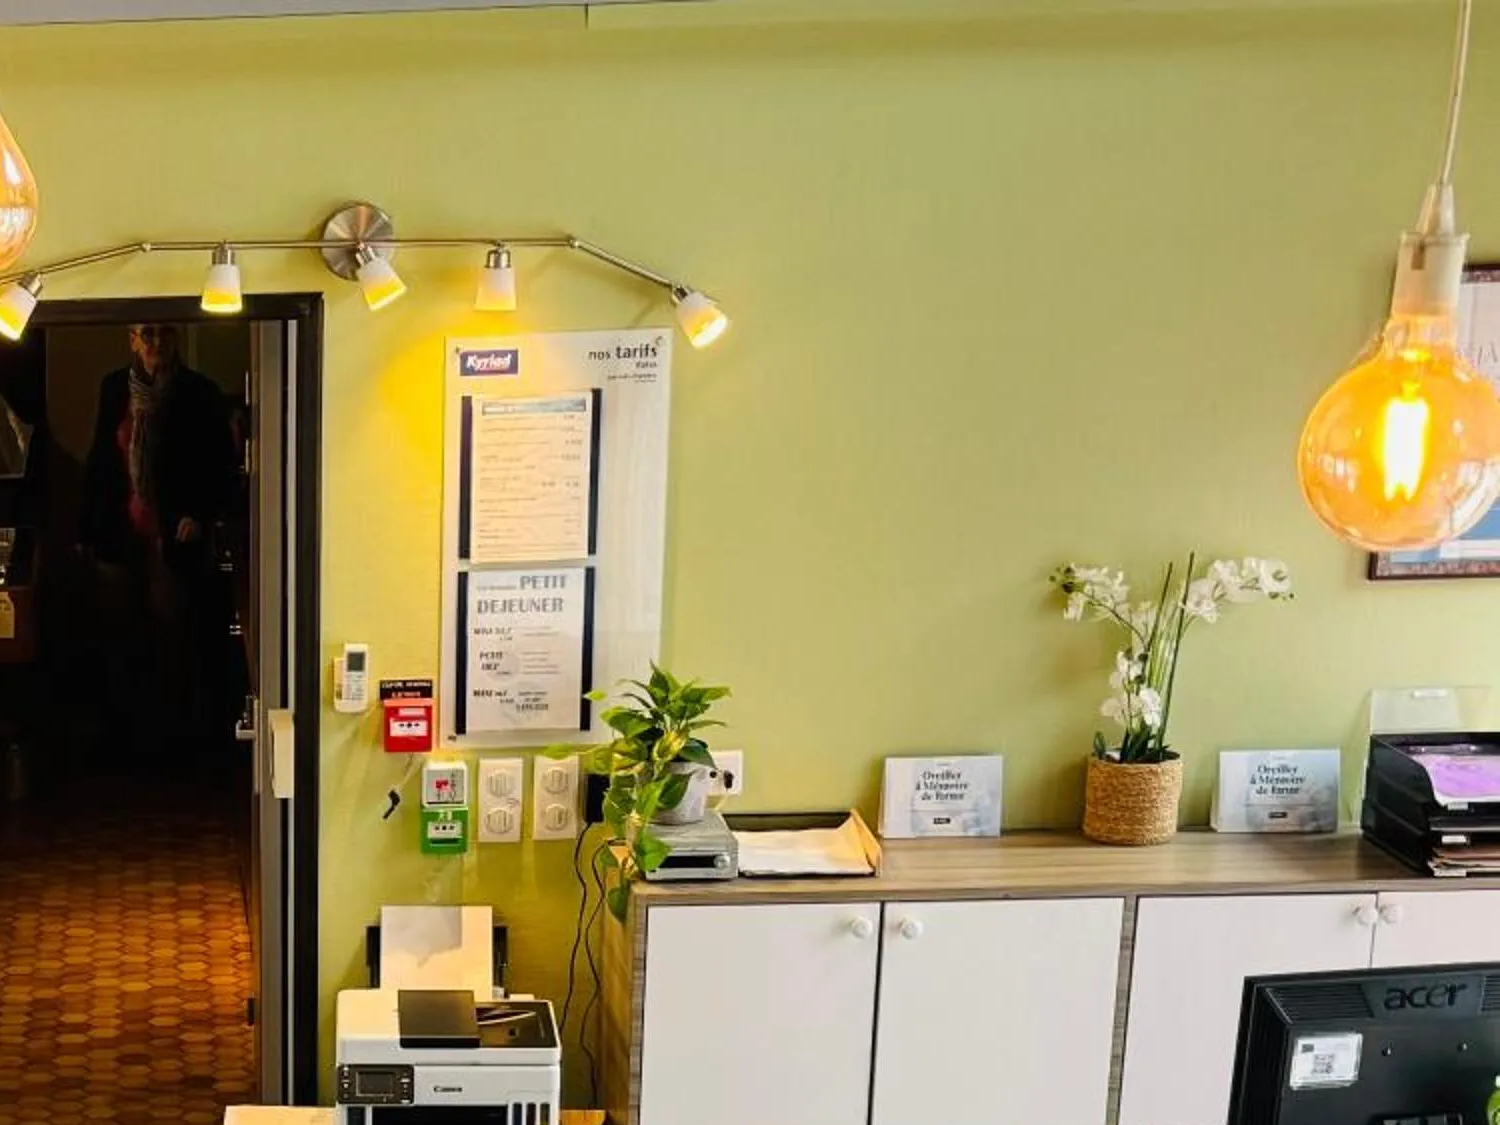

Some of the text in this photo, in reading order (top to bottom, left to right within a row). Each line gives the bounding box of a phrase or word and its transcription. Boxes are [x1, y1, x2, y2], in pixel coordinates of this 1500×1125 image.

[588, 343, 658, 361] nos tarifs
[520, 575, 569, 591] PETIT
[1383, 983, 1467, 1010] acer
